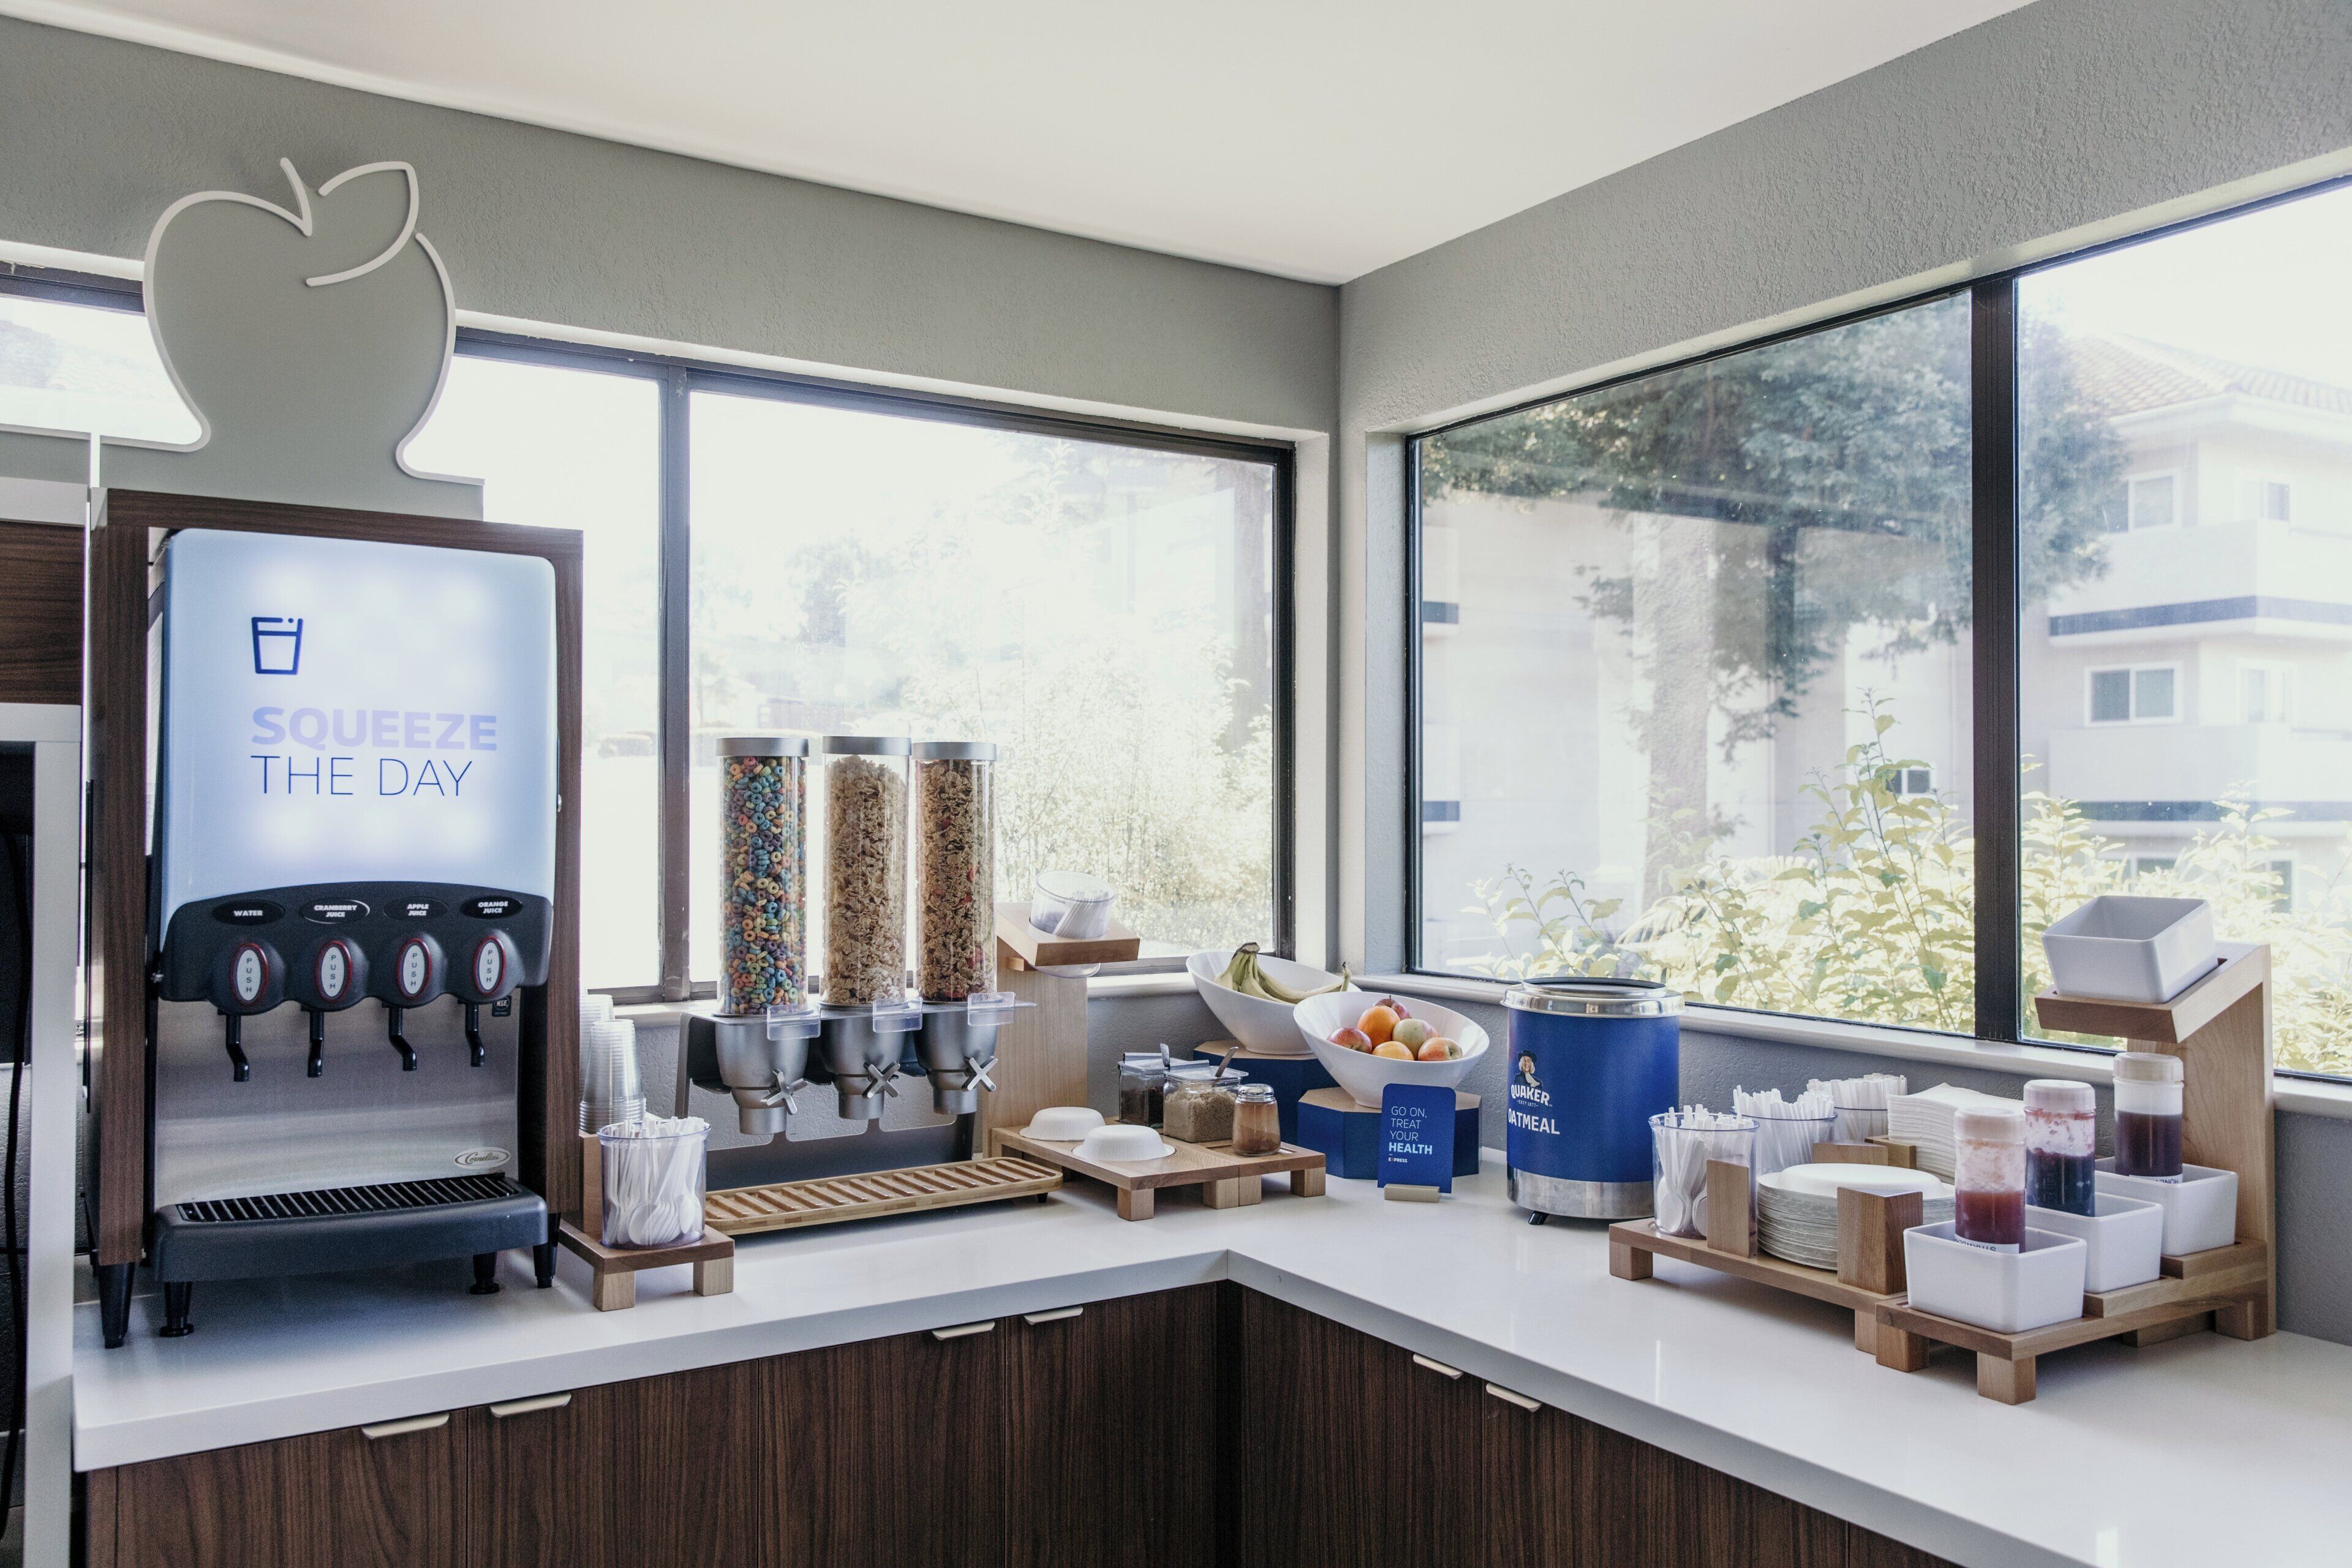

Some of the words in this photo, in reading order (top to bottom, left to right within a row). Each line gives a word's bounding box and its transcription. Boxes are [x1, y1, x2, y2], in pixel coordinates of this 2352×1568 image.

[251, 706, 497, 752] SQUEEZE
[251, 755, 354, 796] THE
[379, 758, 473, 797] DAY
[1510, 1084, 1550, 1106] QUAKER
[1391, 1106, 1406, 1115] GO
[1409, 1107, 1427, 1118] ON,
[1390, 1118, 1421, 1129] TREAT
[1508, 1108, 1560, 1135] OATMEAL
[1390, 1130, 1419, 1141] YOUR
[1389, 1142, 1433, 1155] HEALTH
[465, 1152, 499, 1164] Cornelius
